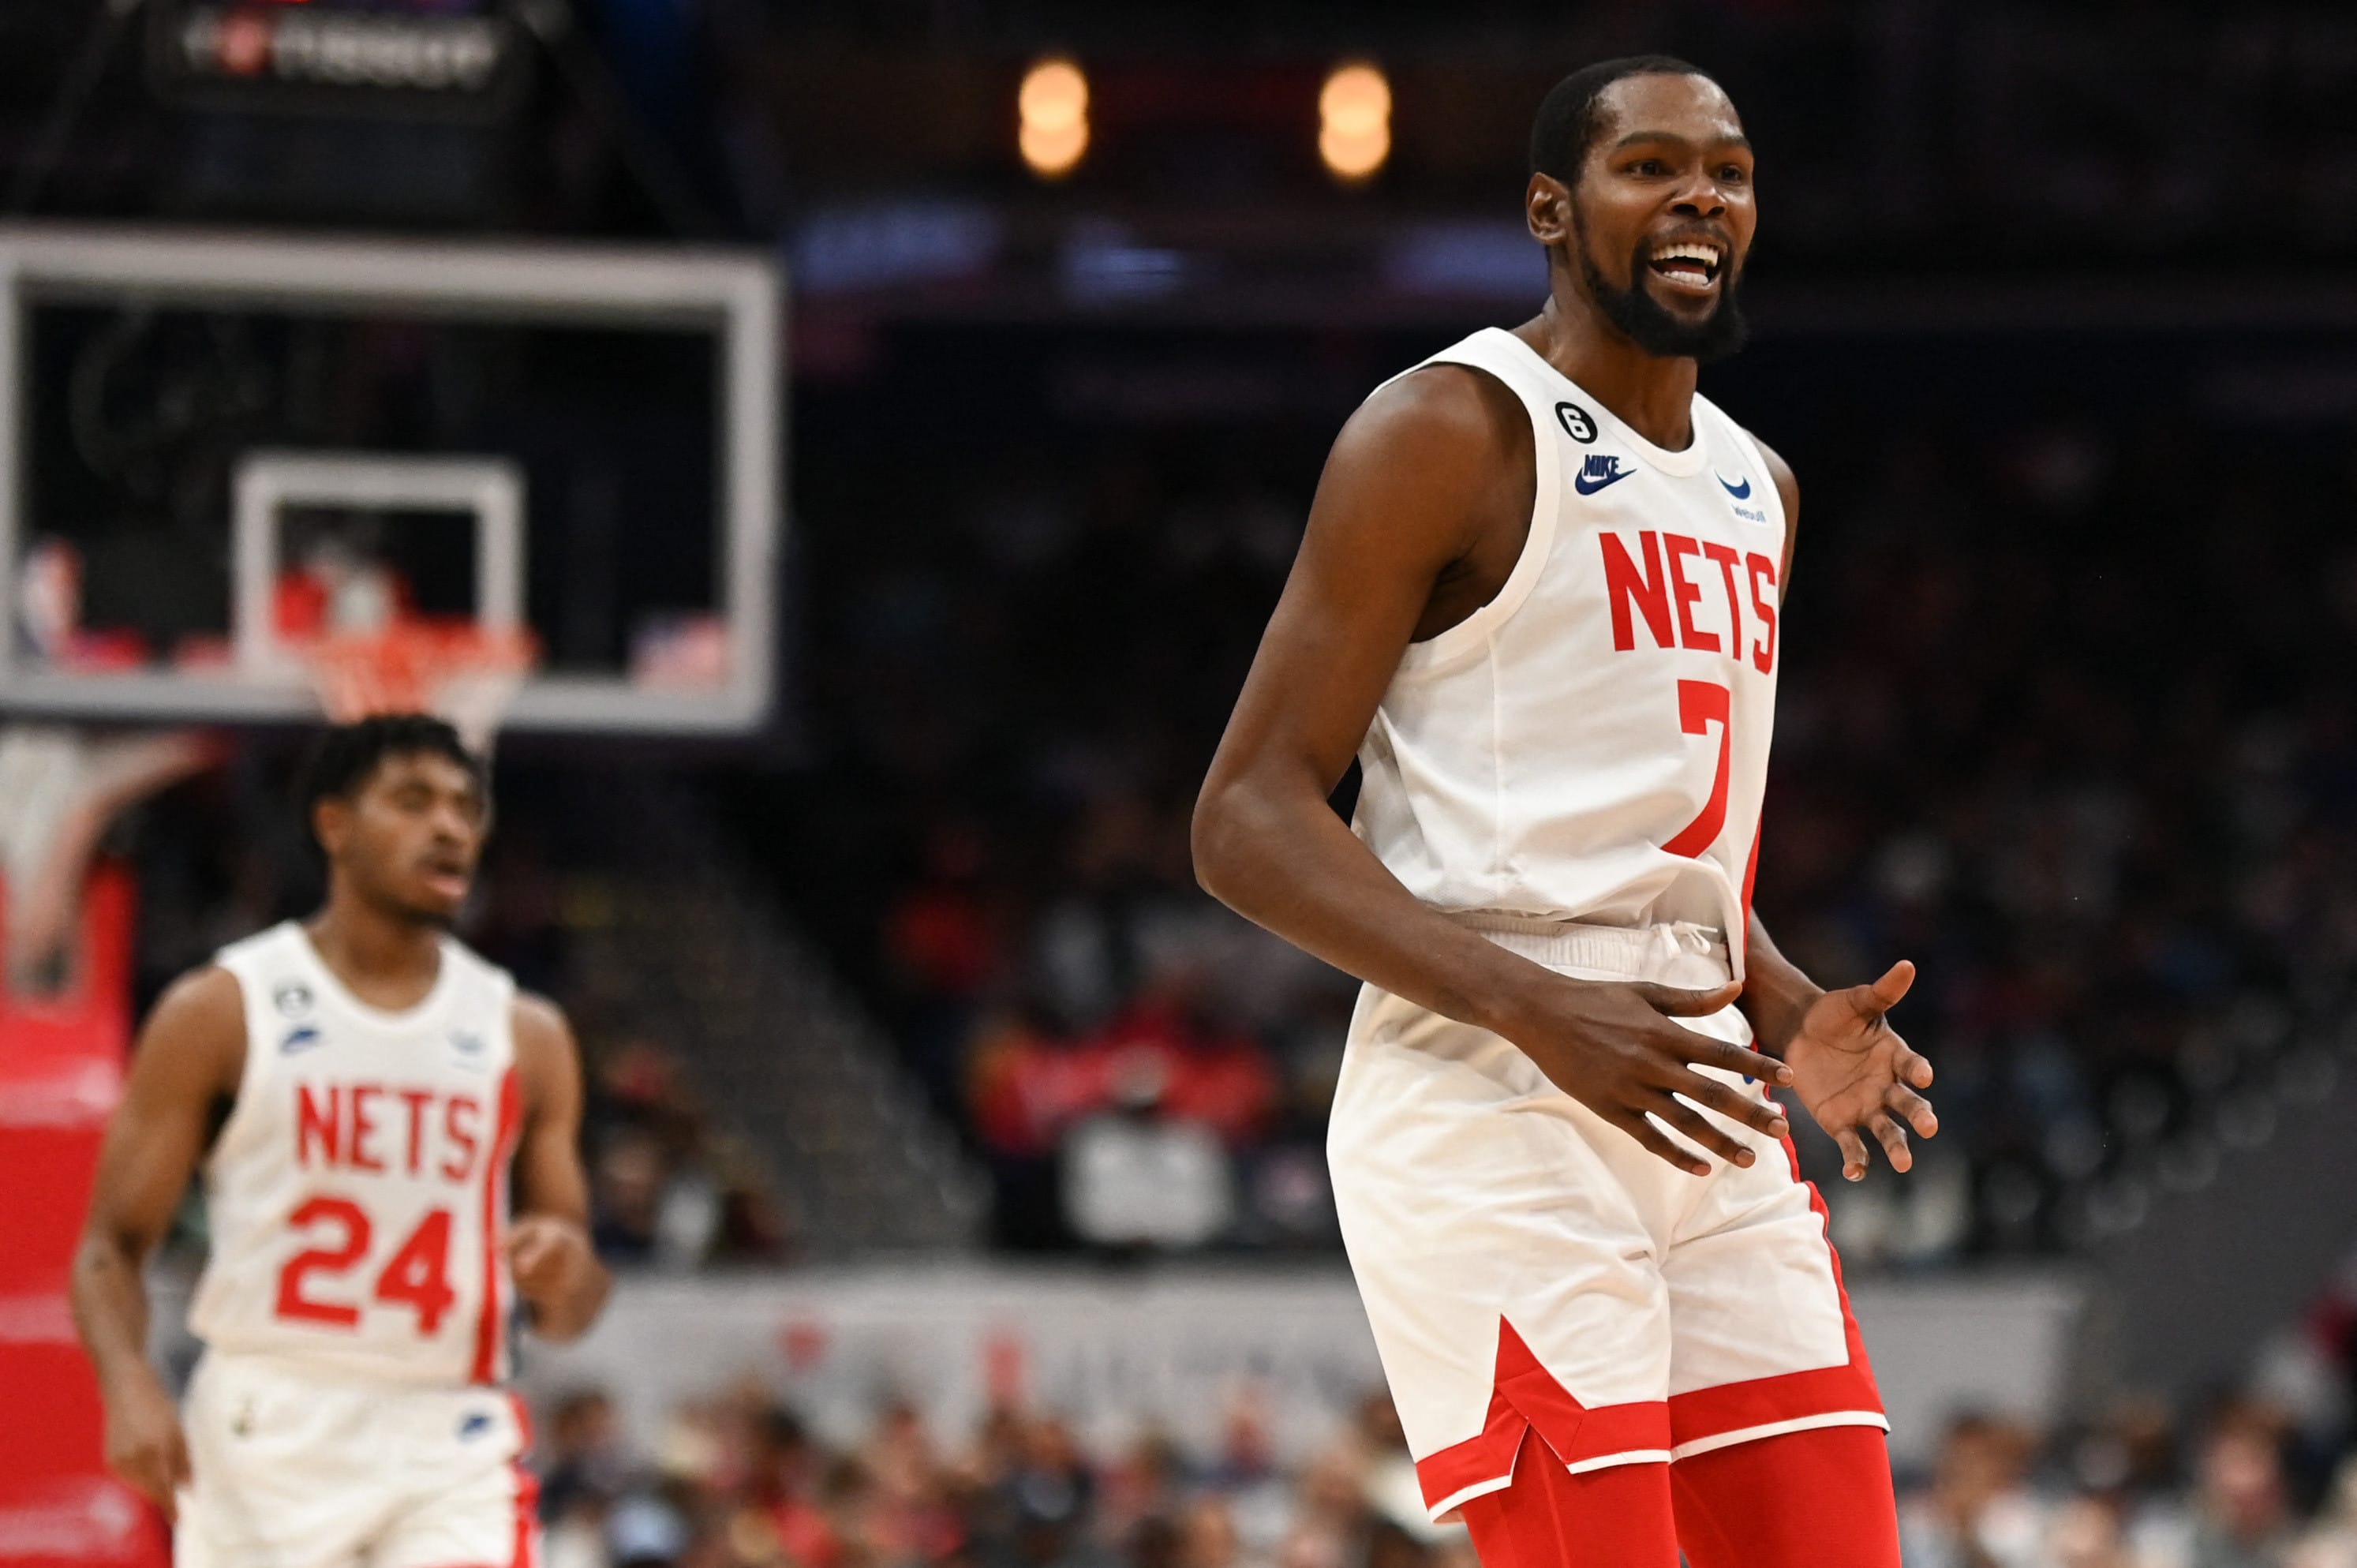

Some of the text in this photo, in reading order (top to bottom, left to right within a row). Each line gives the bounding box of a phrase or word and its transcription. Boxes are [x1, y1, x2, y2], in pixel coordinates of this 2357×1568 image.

[1562, 407, 1592, 440] 6
[1583, 453, 1620, 478] NIKE
[1598, 530, 1776, 676] NETS
[1660, 679, 1730, 859] 7
[294, 1082, 481, 1182] NETS
[273, 1192, 457, 1339] 24
